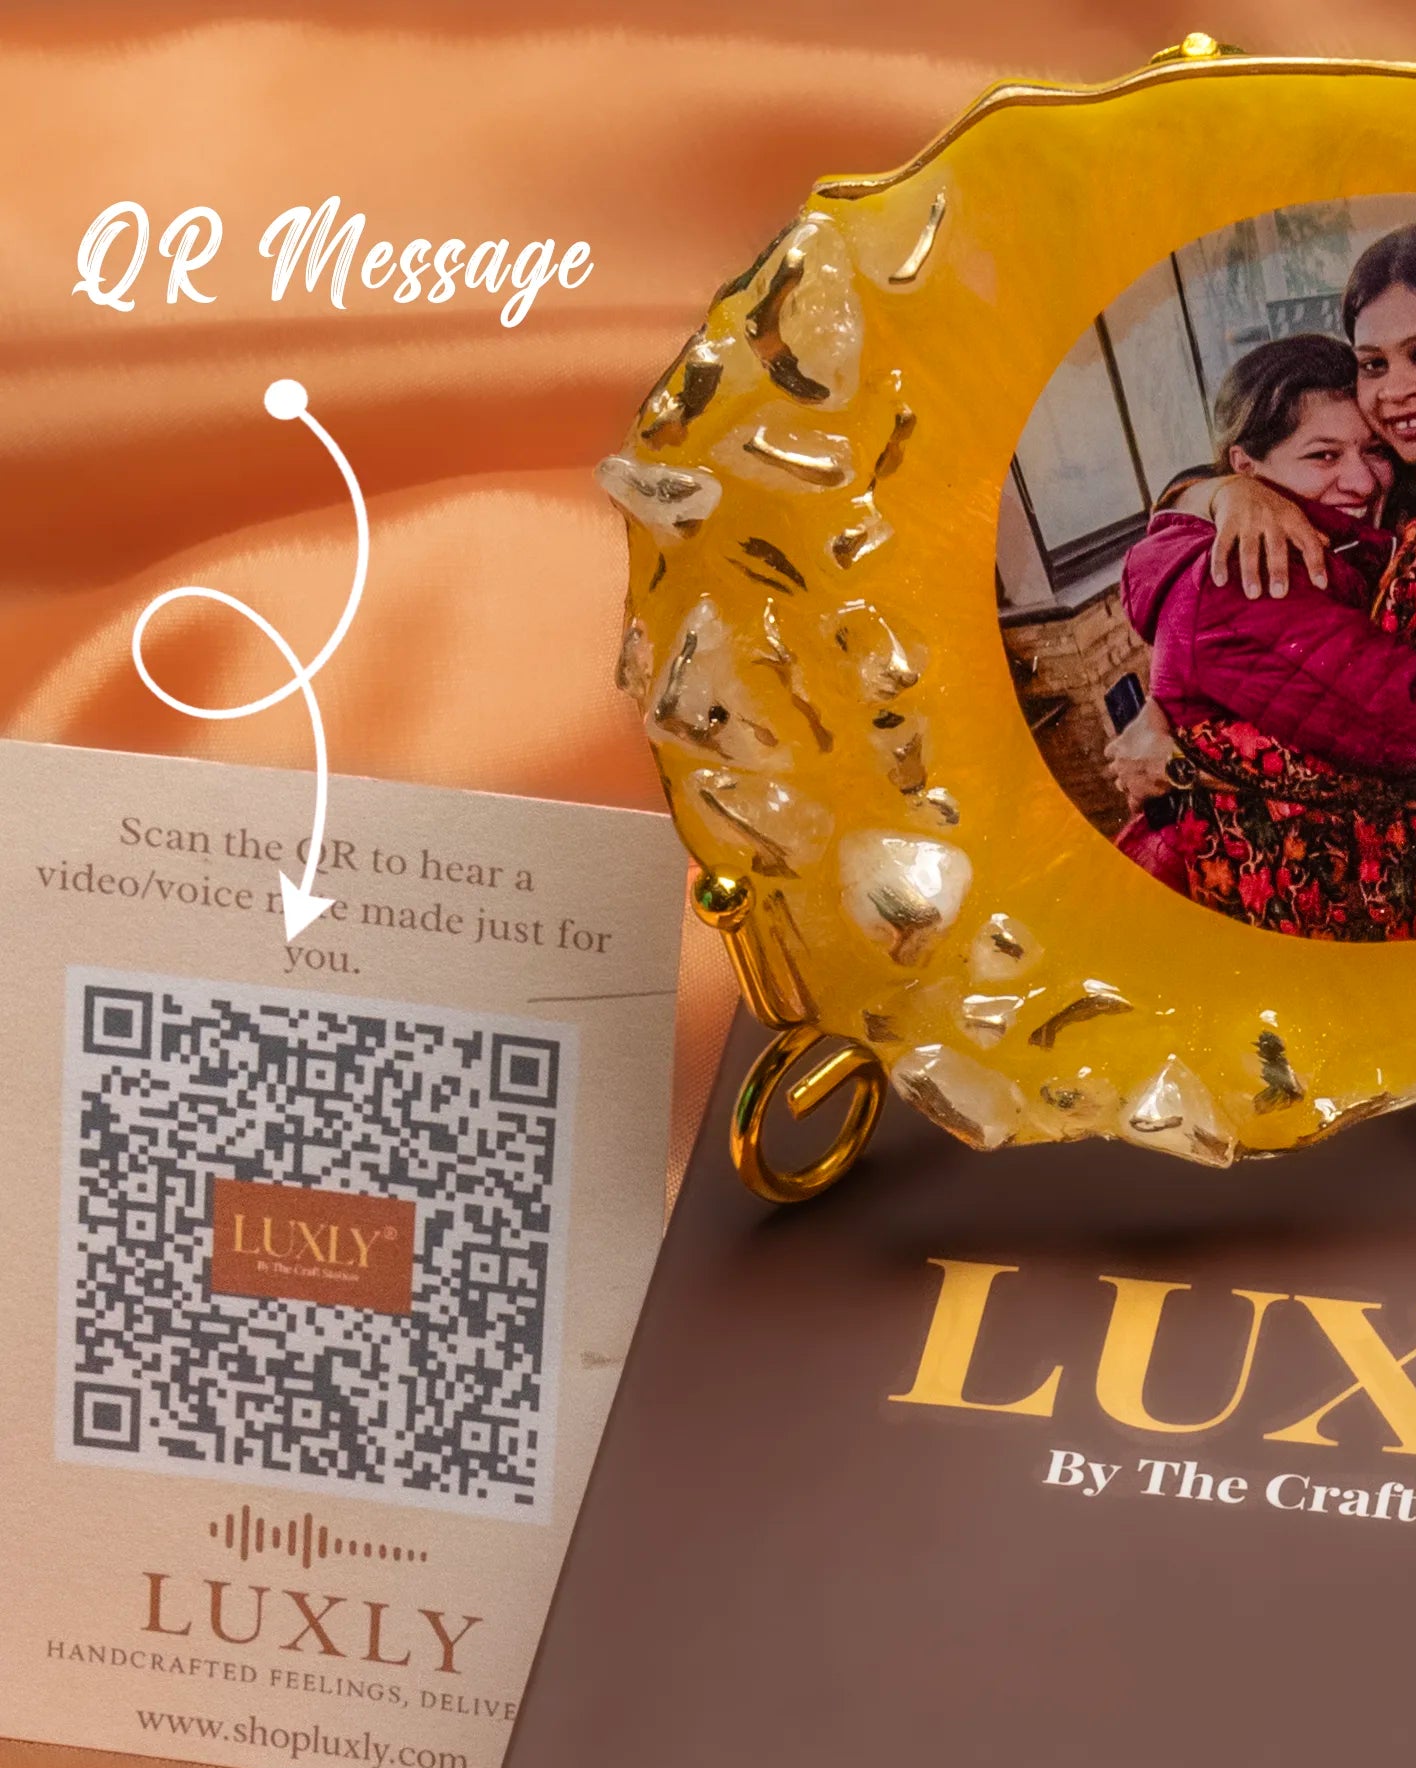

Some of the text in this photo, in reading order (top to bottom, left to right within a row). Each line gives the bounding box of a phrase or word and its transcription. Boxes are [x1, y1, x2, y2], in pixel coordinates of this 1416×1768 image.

[120, 816, 535, 893] Scan the QR to hear a
[36, 861, 253, 912] video/voice
[362, 897, 465, 936] made
[475, 908, 545, 948] just
[558, 918, 613, 955] for
[283, 940, 361, 975] you.
[1041, 1448, 1121, 1497] By
[1136, 1458, 1248, 1506] The
[140, 1571, 484, 1675] LUXLY
[46, 1639, 517, 1721] HANDCRAFTED FEELINGS, DELIVE
